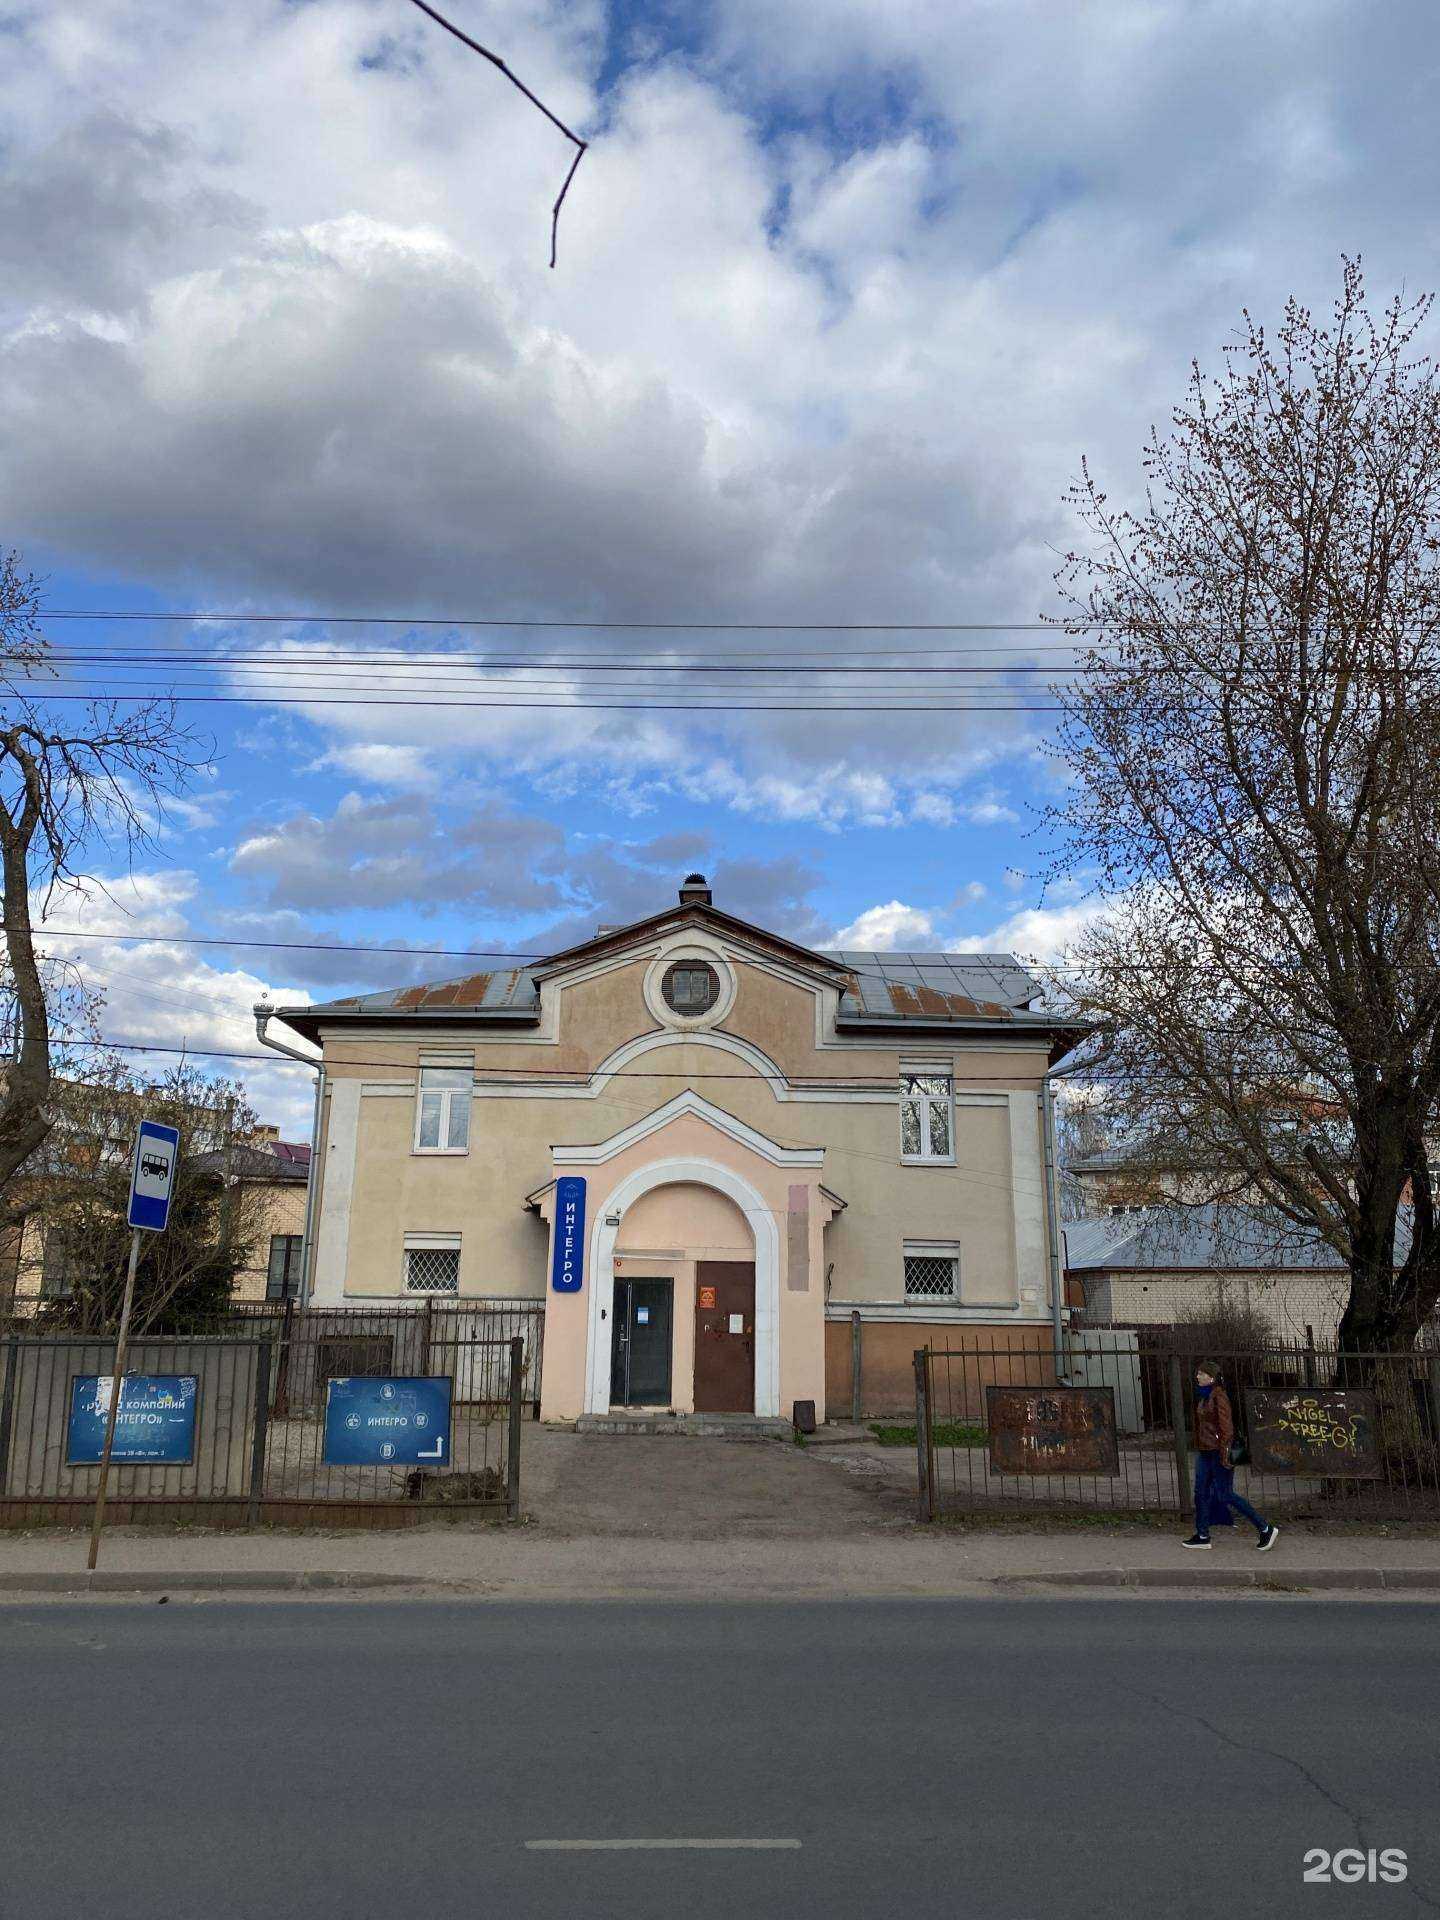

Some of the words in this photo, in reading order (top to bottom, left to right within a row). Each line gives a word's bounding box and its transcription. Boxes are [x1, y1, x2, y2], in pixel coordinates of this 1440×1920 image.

[562, 1202, 576, 1284] ИНТЕГРО
[126, 1398, 186, 1410] компаний
[101, 1413, 163, 1425] «НТЕГРО»
[367, 1416, 408, 1427] ИНТЕГРО
